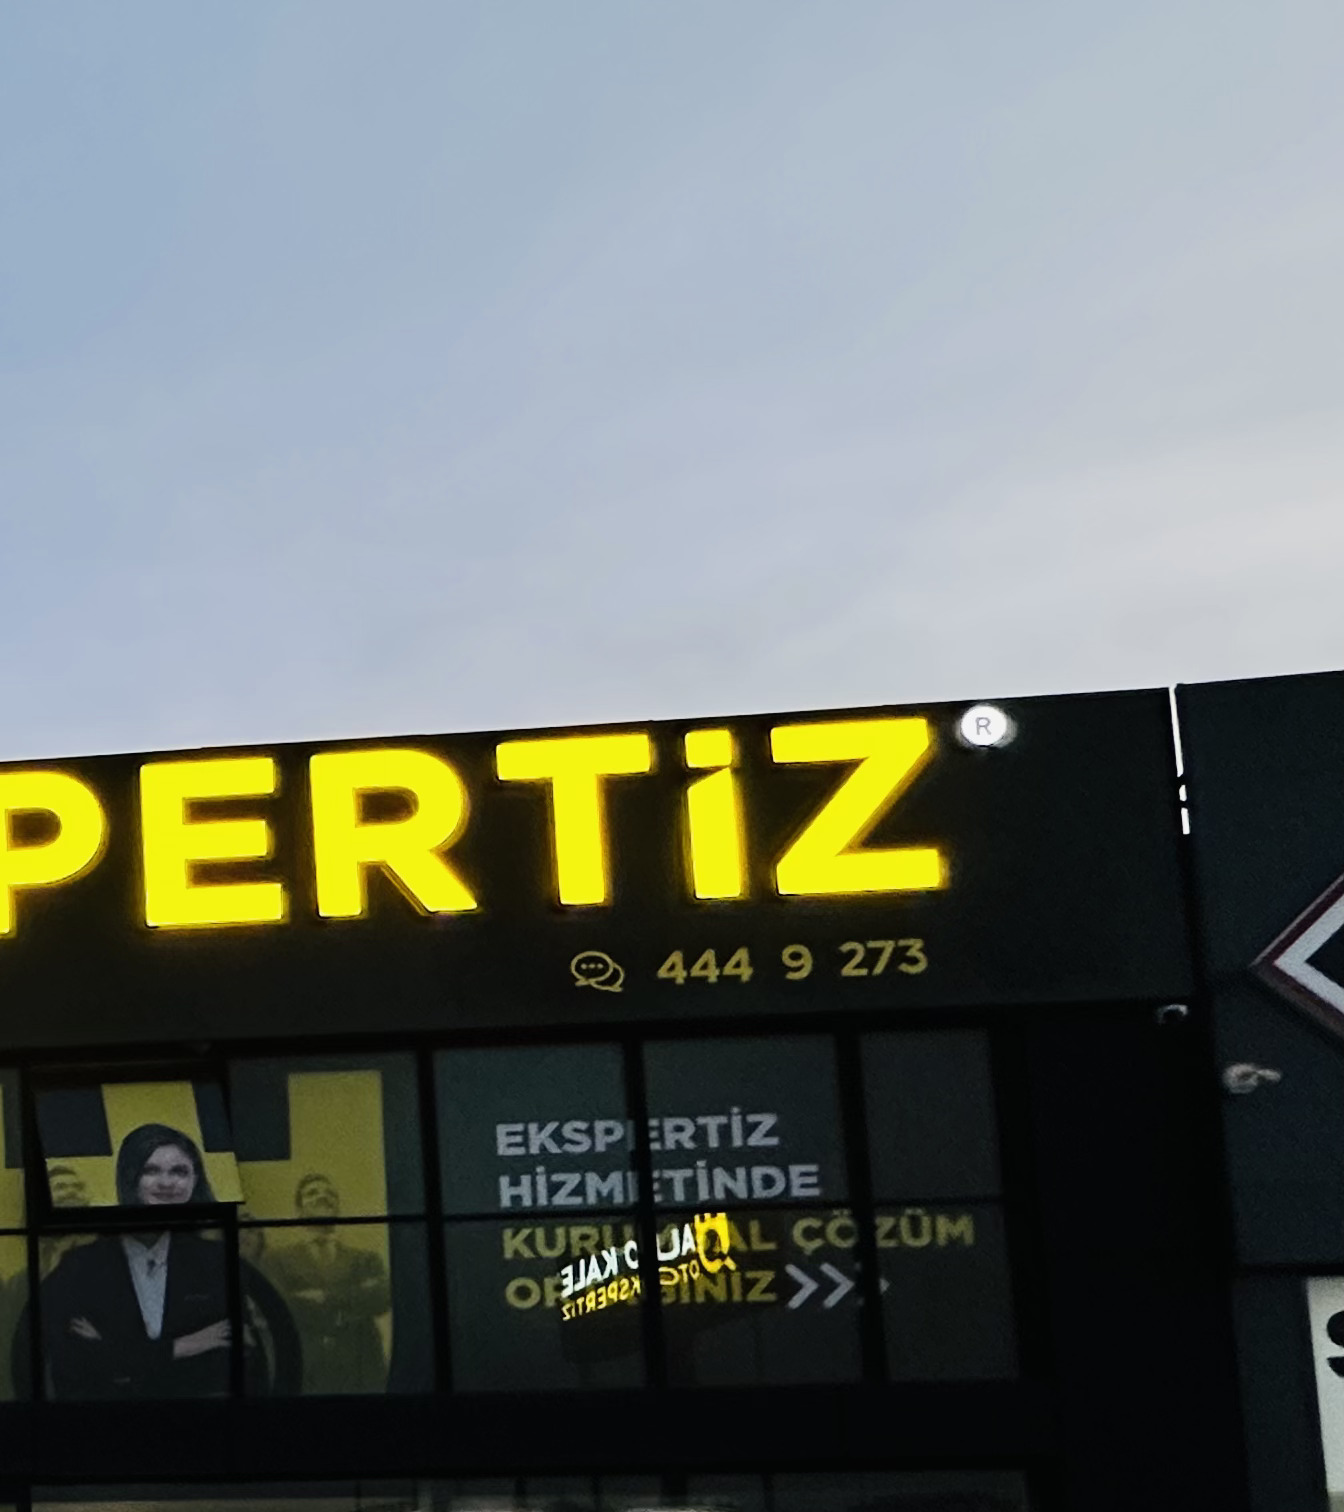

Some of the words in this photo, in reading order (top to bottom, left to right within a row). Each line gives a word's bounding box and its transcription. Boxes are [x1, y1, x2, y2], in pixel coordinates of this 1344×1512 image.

[657, 947, 753, 984] 444
[781, 944, 813, 981] 9
[839, 939, 928, 977] 273
